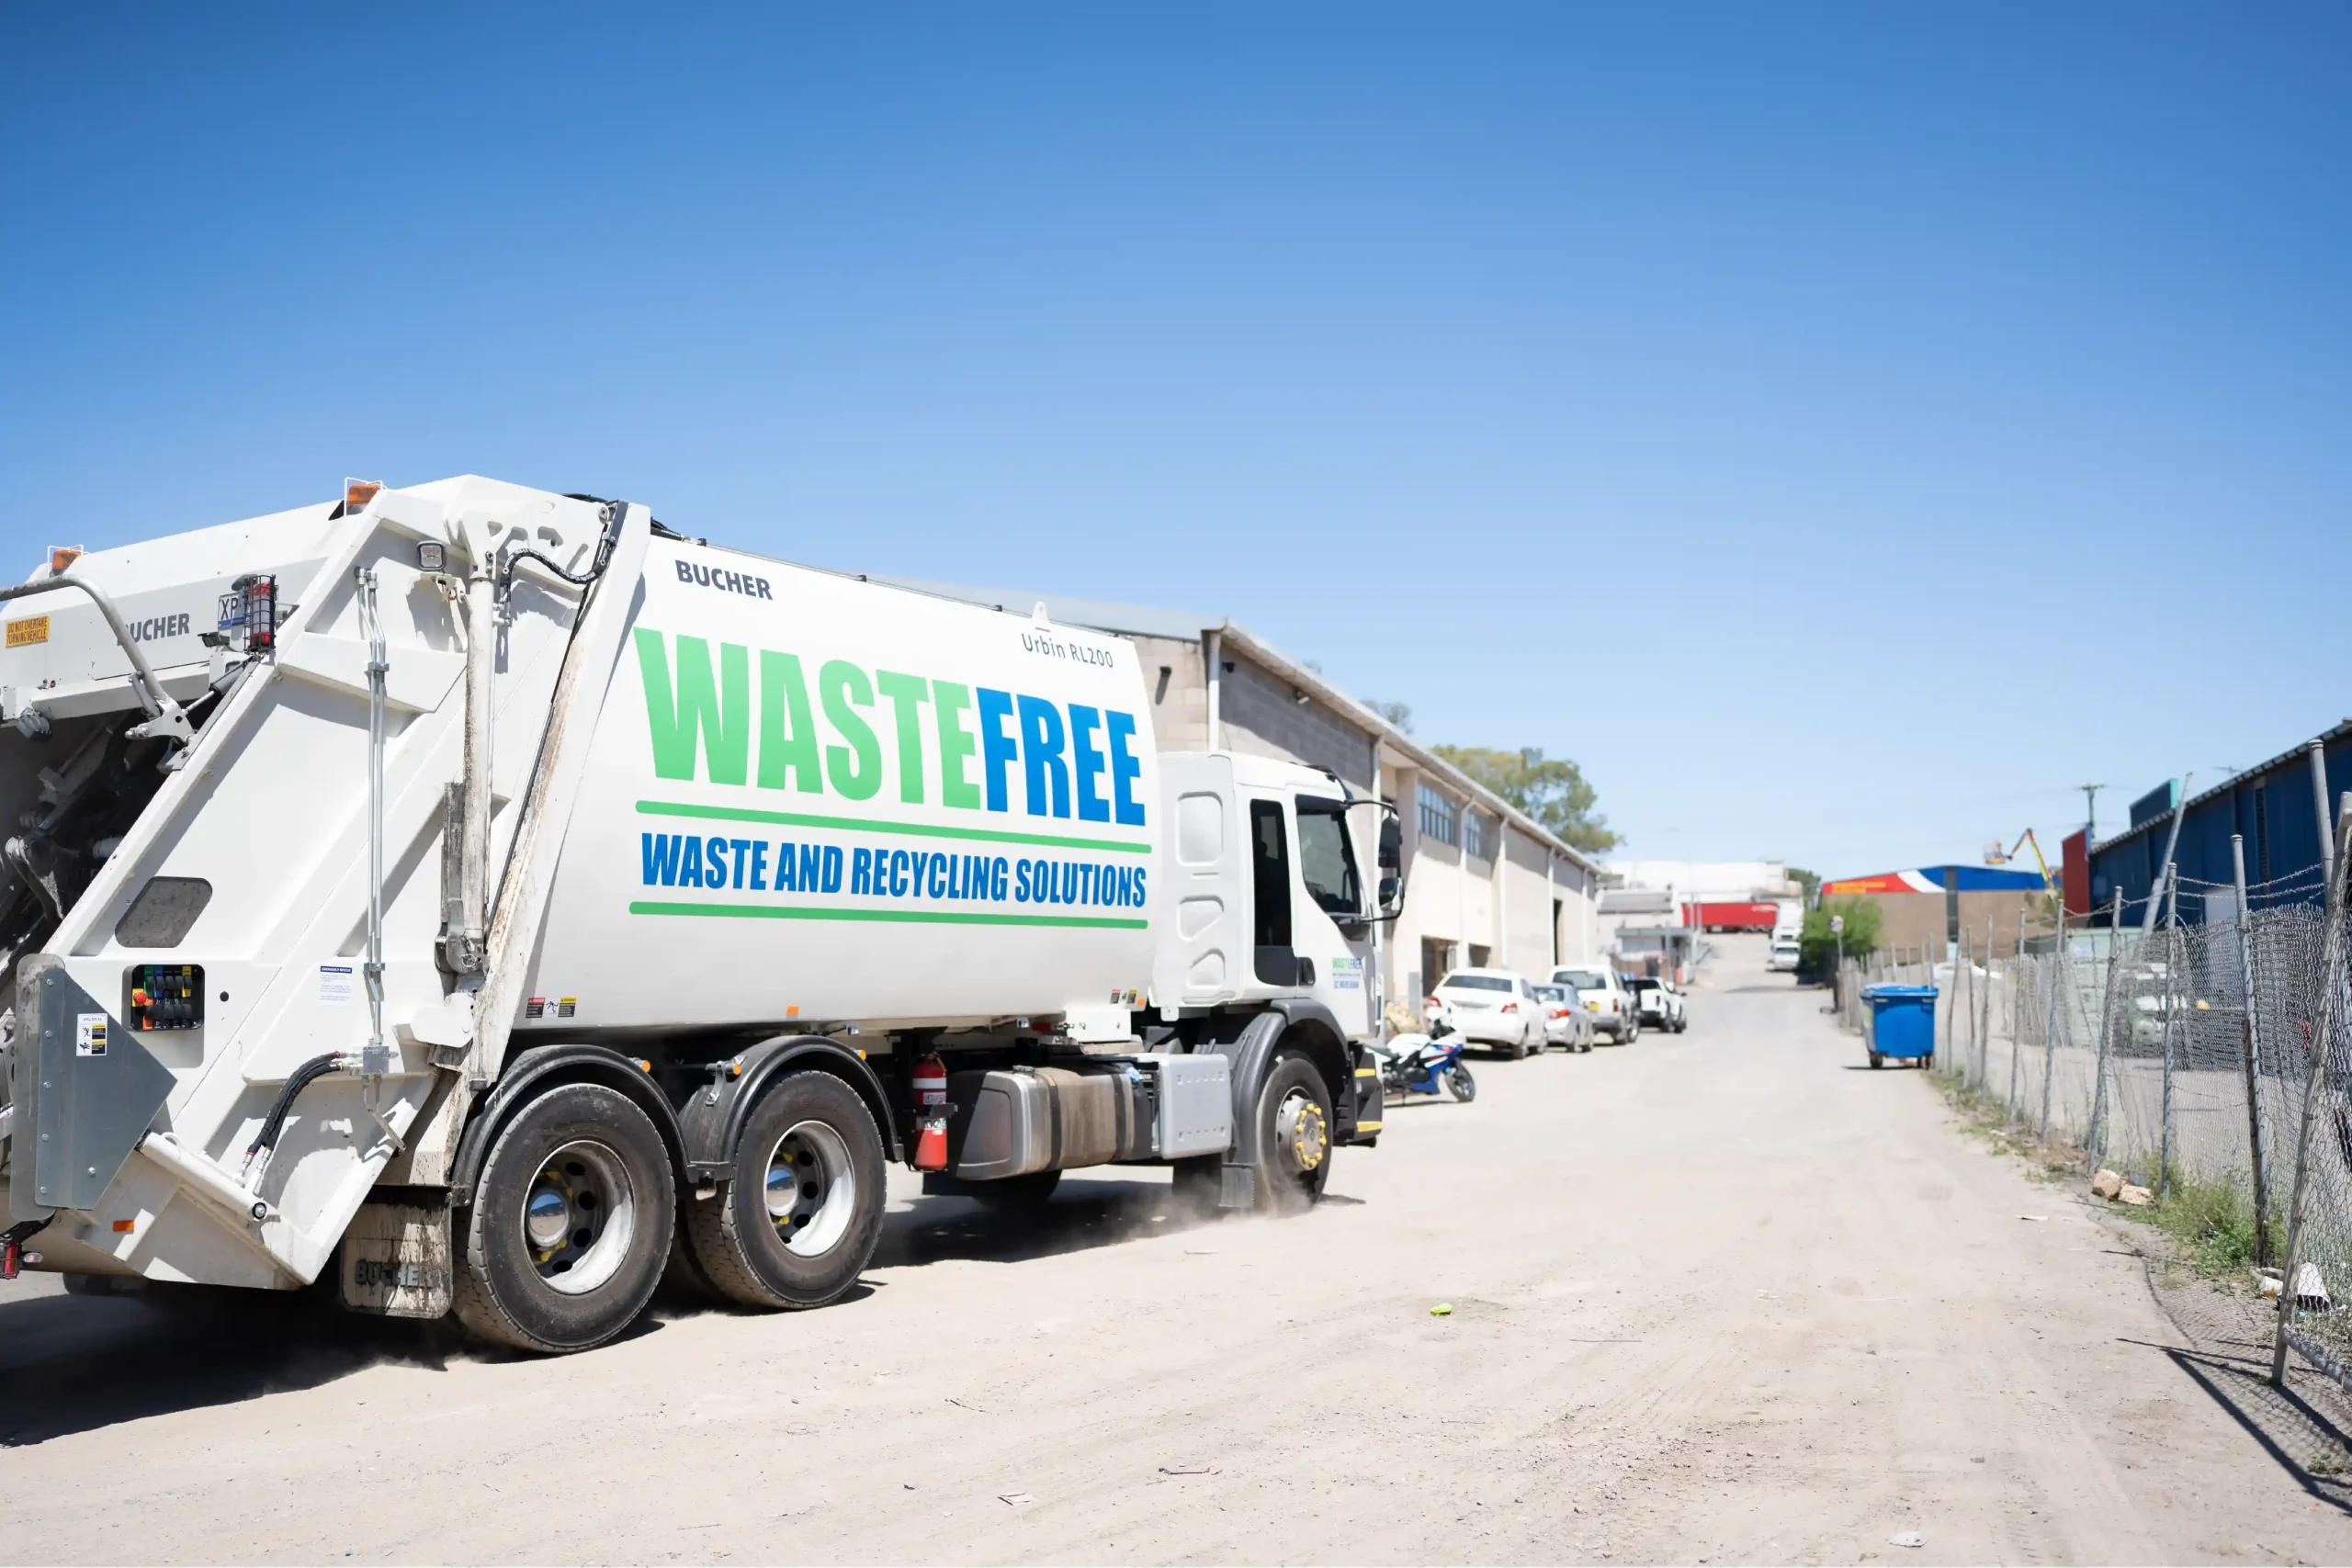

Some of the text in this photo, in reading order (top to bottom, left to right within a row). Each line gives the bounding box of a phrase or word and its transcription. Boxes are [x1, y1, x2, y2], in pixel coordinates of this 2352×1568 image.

[675, 559, 774, 601] BUCHER
[117, 614, 190, 646] UCHER
[1021, 633, 1114, 668] Urbin RL200
[641, 831, 1147, 909] WASTE AND RECYCLING SOLUTIONS
